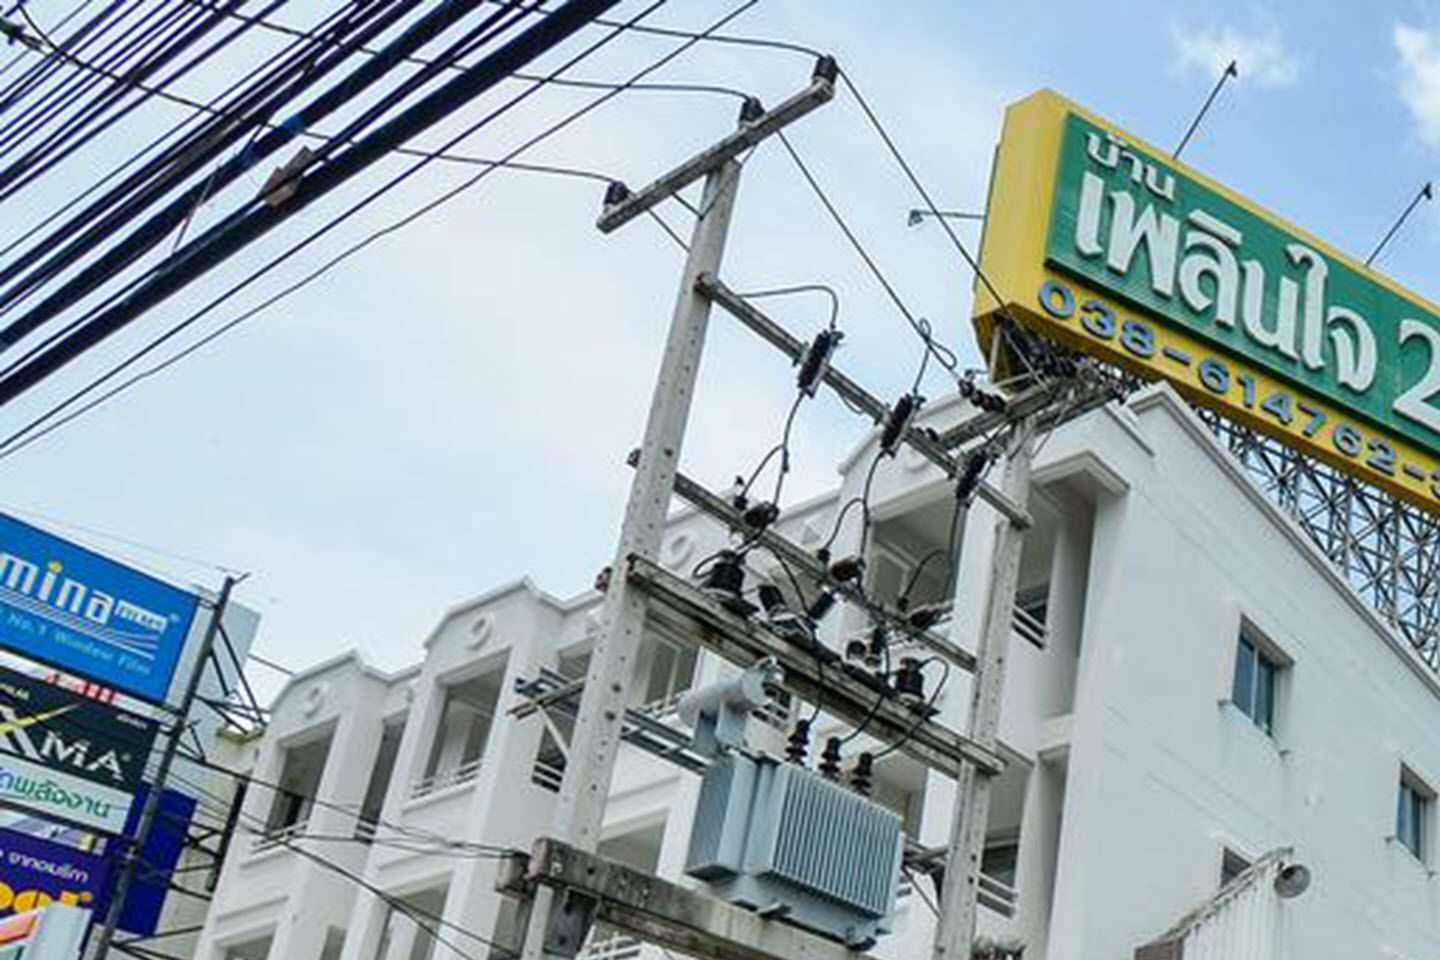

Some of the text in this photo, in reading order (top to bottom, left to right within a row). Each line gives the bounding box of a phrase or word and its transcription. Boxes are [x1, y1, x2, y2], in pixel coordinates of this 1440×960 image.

[1085, 131, 1175, 202] บ้าน
[1076, 172, 1380, 393] เพลินใจ
